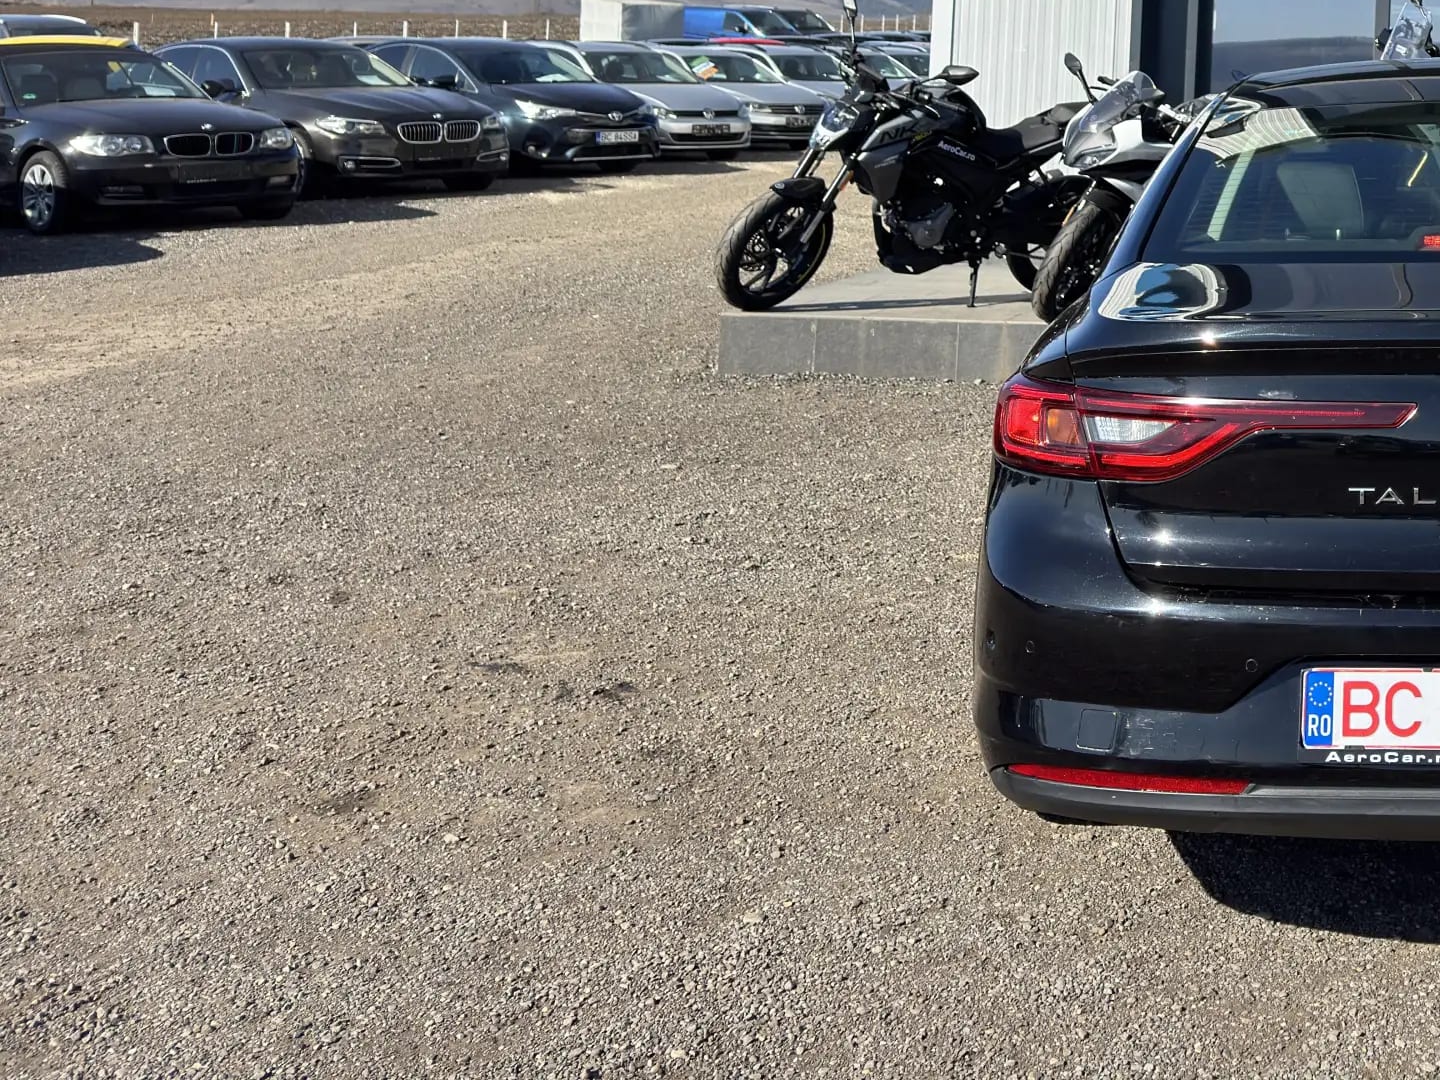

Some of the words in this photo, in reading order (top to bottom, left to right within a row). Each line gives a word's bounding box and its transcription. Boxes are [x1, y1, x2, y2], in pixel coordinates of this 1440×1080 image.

[937, 140, 976, 161] AeroCar.ro
[1307, 713, 1332, 738] RO
[1342, 680, 1422, 738] BC
